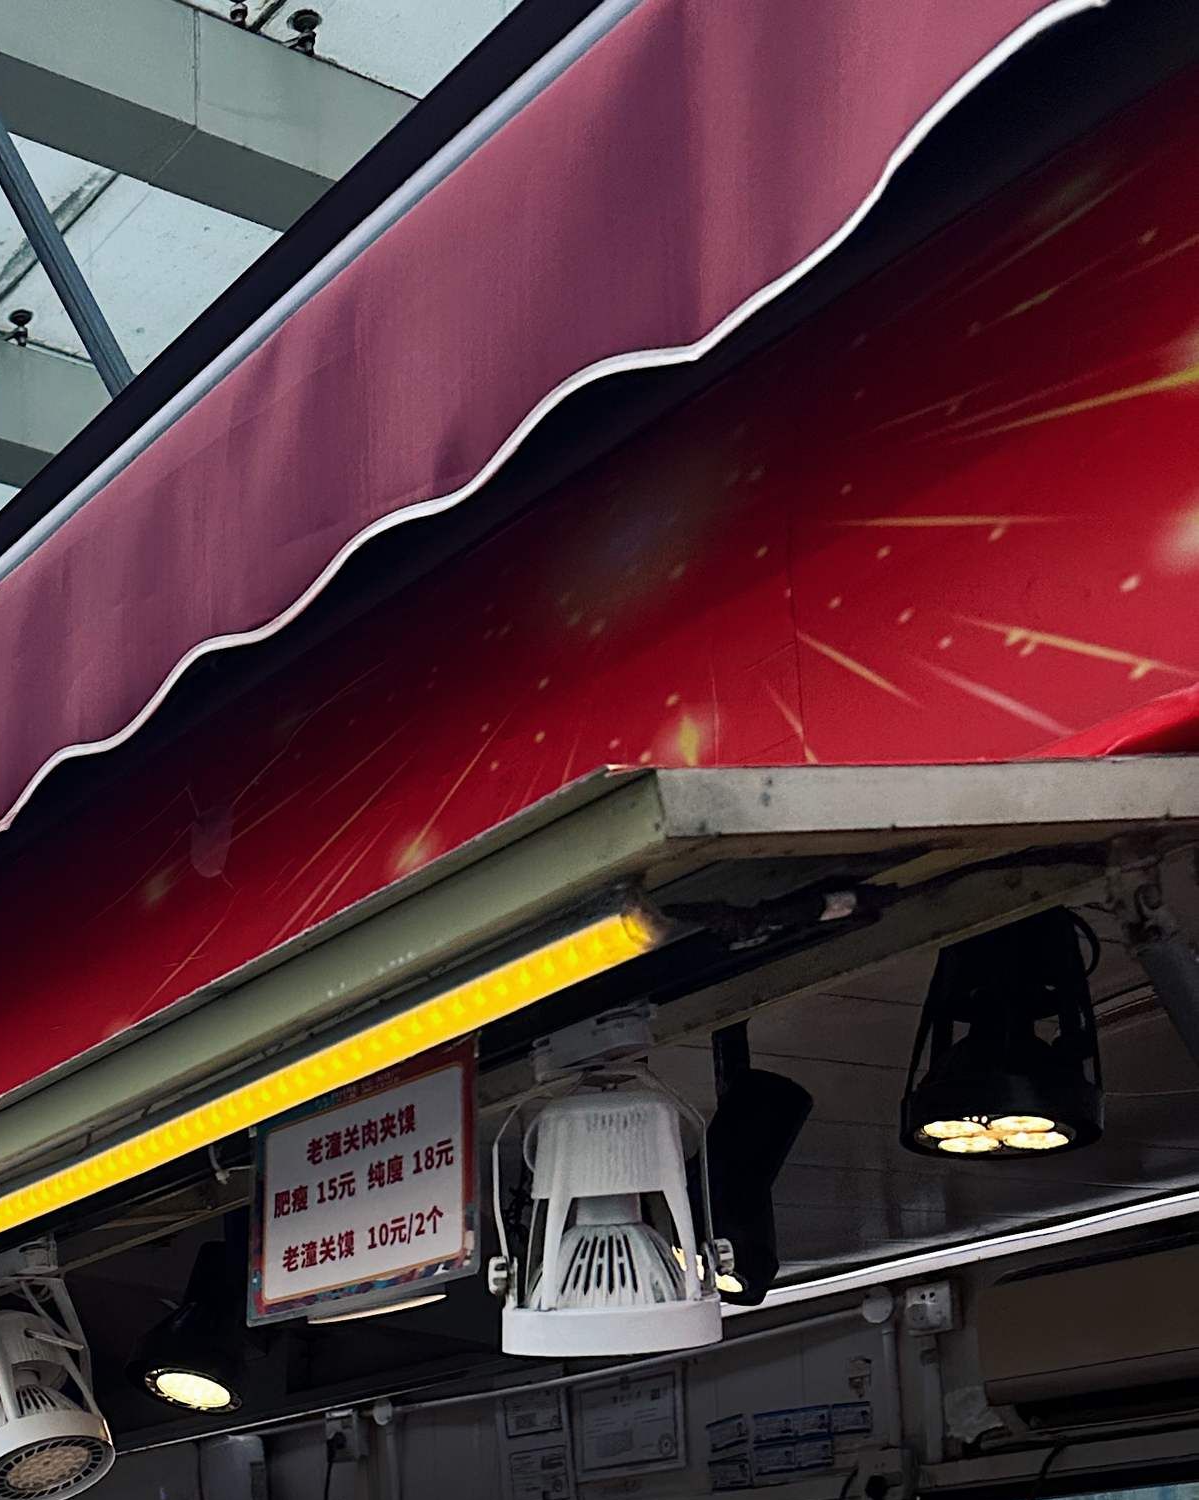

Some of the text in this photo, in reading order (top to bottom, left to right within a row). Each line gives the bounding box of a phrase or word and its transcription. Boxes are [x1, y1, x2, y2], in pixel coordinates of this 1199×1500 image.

[307, 1104, 416, 1165] 老潼关肉夹馍
[274, 1185, 308, 1219] 肥瘦
[317, 1171, 356, 1204] 15元
[412, 1138, 454, 1175] 18元
[283, 1205, 444, 1272] 老潼关馍 10元/2个
